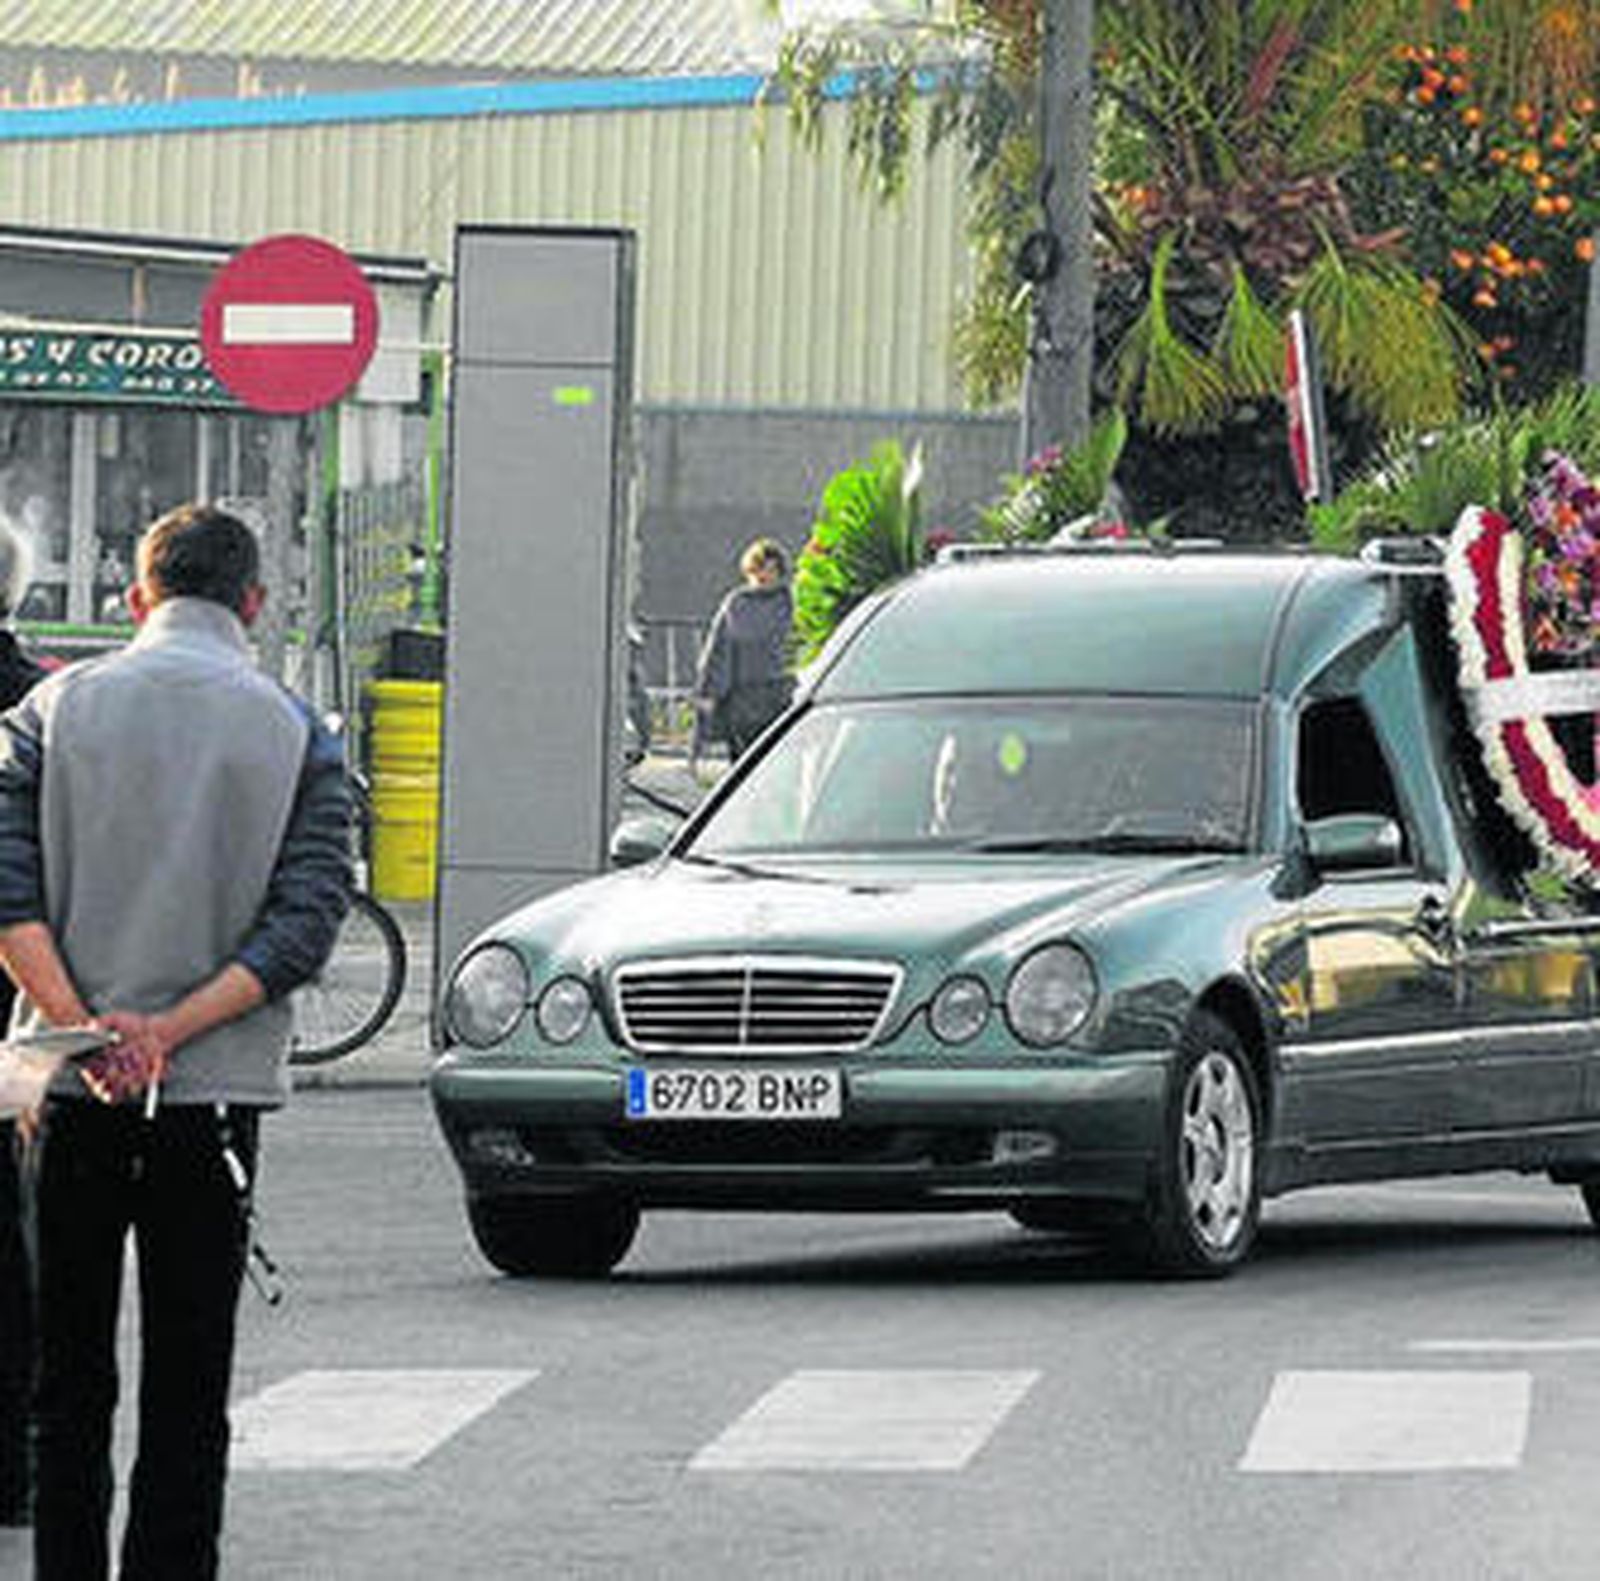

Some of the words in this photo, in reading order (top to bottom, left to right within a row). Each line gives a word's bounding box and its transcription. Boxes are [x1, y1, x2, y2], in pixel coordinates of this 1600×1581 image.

[0, 338, 34, 364] S
[87, 340, 210, 370] CORO
[652, 1074, 747, 1111] 6702
[758, 1074, 831, 1111] BNP
